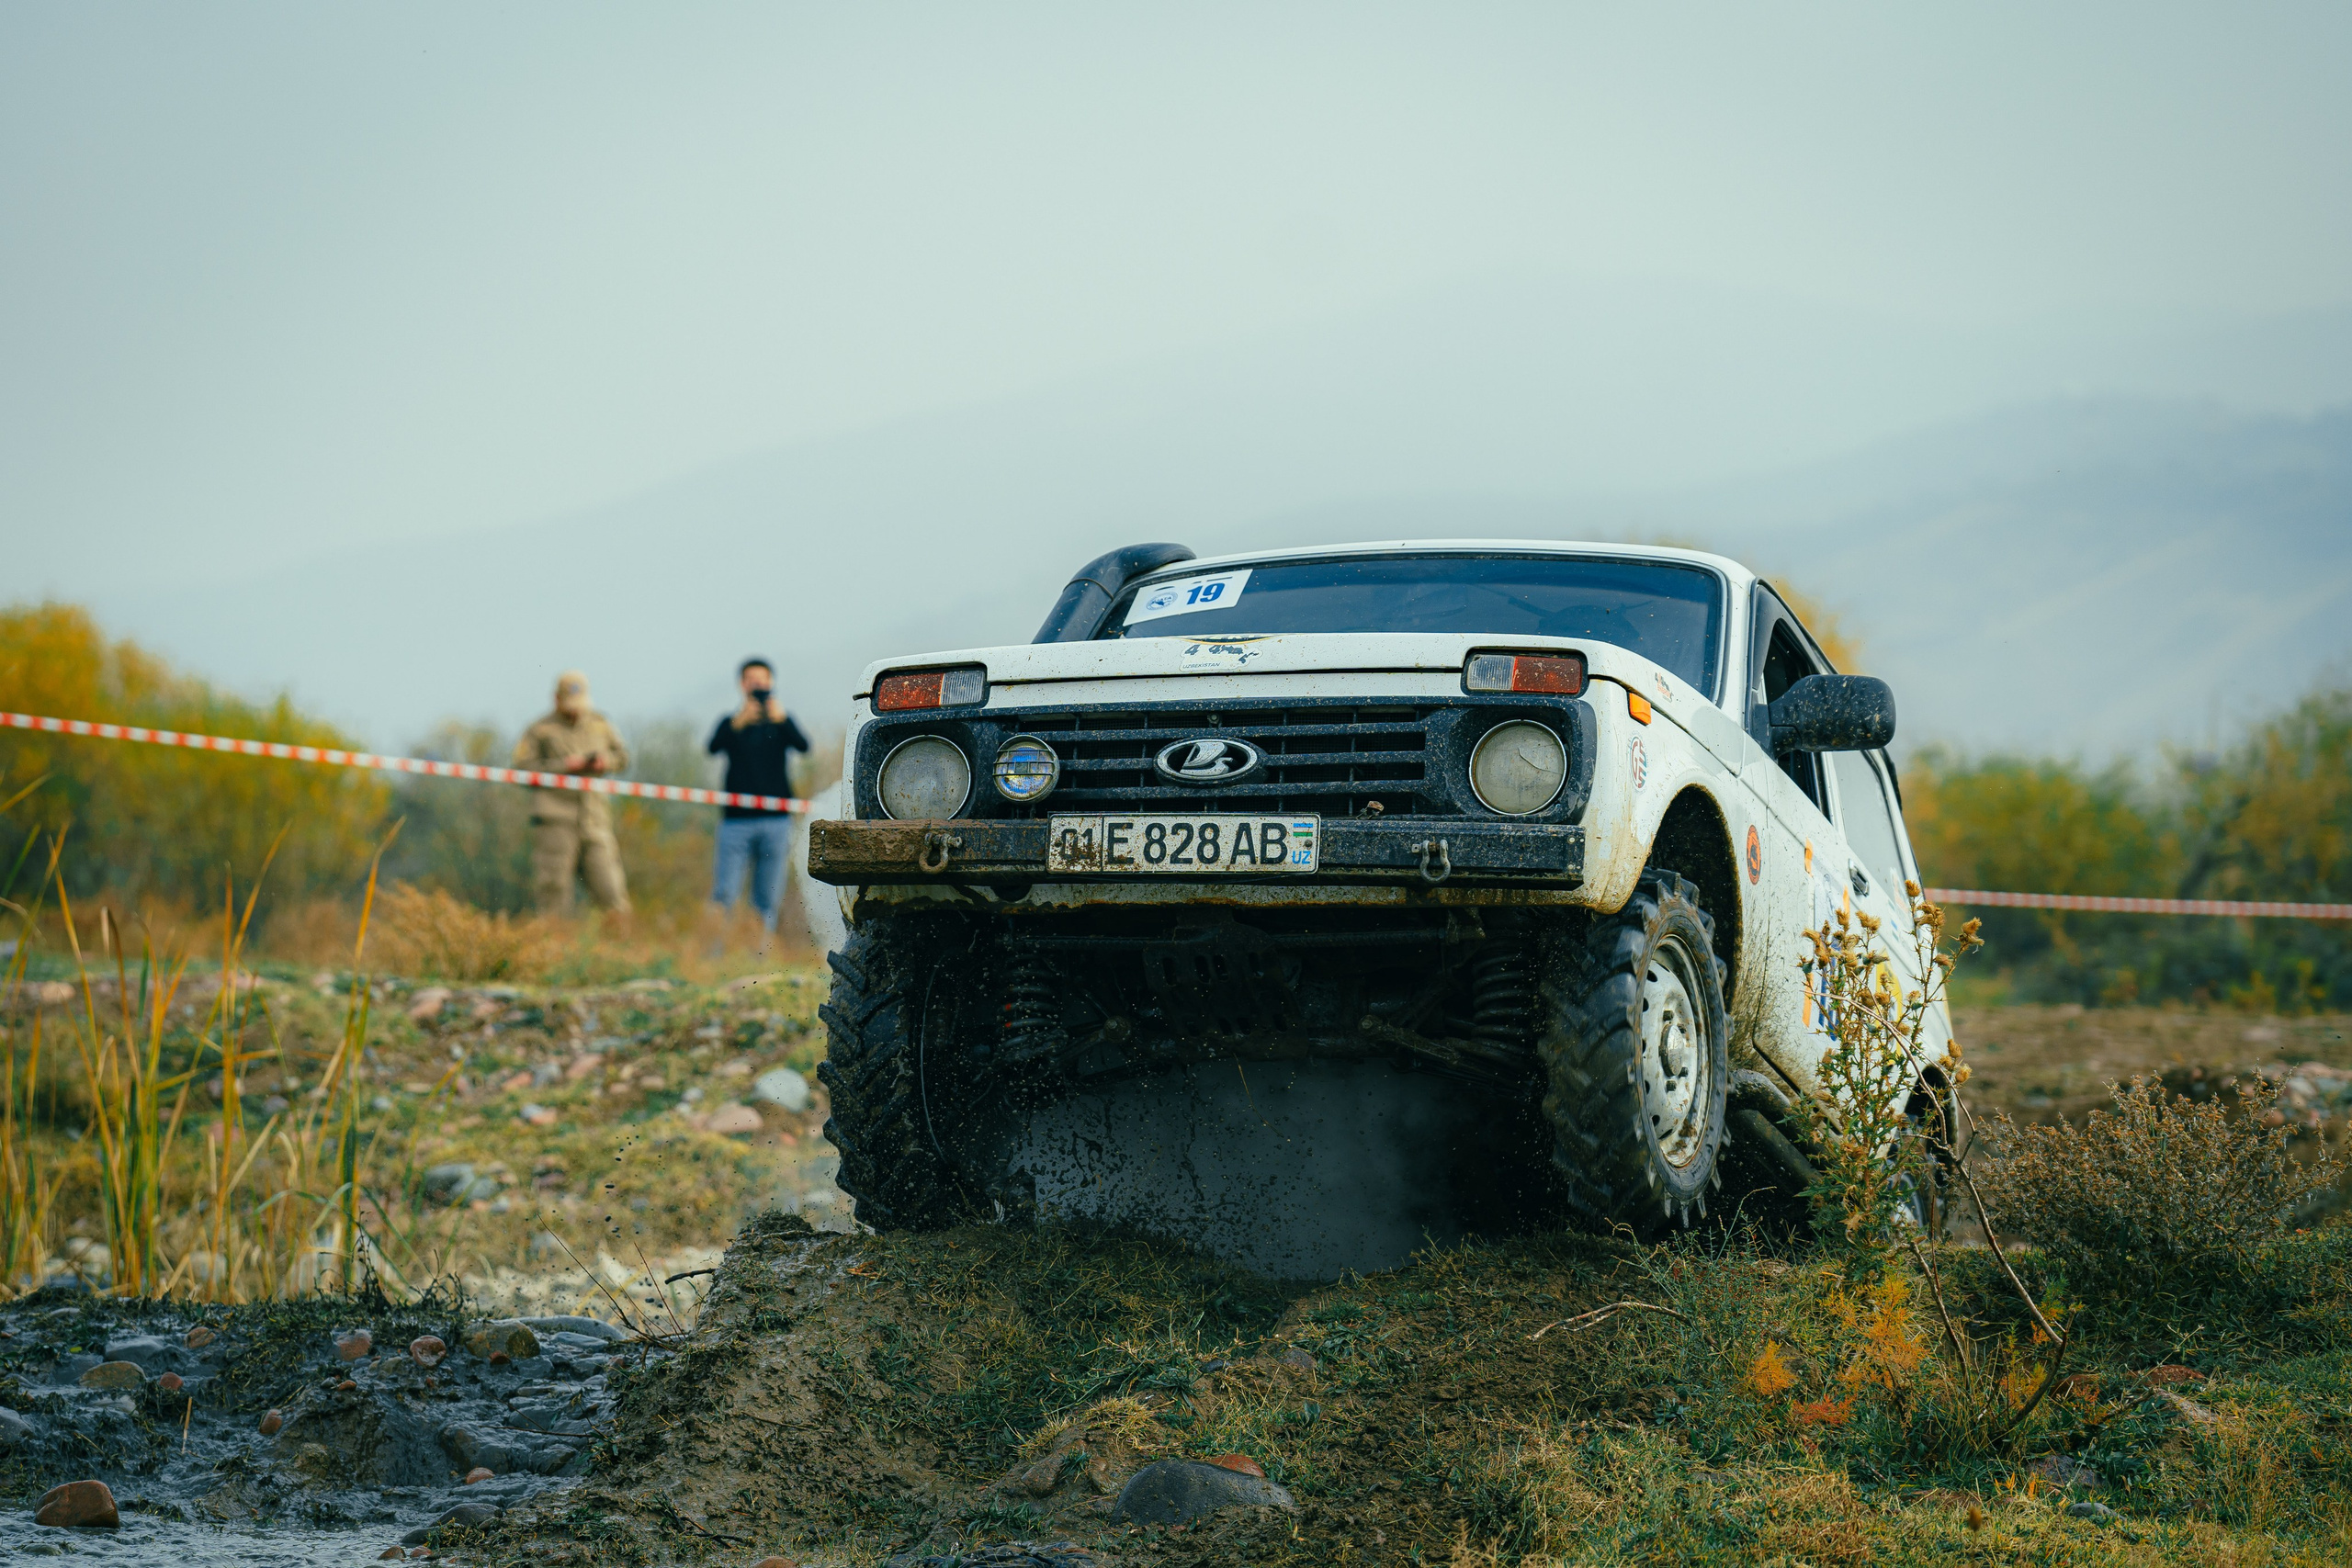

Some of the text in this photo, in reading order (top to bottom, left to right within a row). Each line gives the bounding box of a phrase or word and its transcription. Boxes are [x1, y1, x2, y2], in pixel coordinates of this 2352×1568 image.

[1186, 582, 1226, 605] 19
[1060, 822, 1288, 864] 01 E 828 AB
[1292, 851, 1312, 864] UZ
